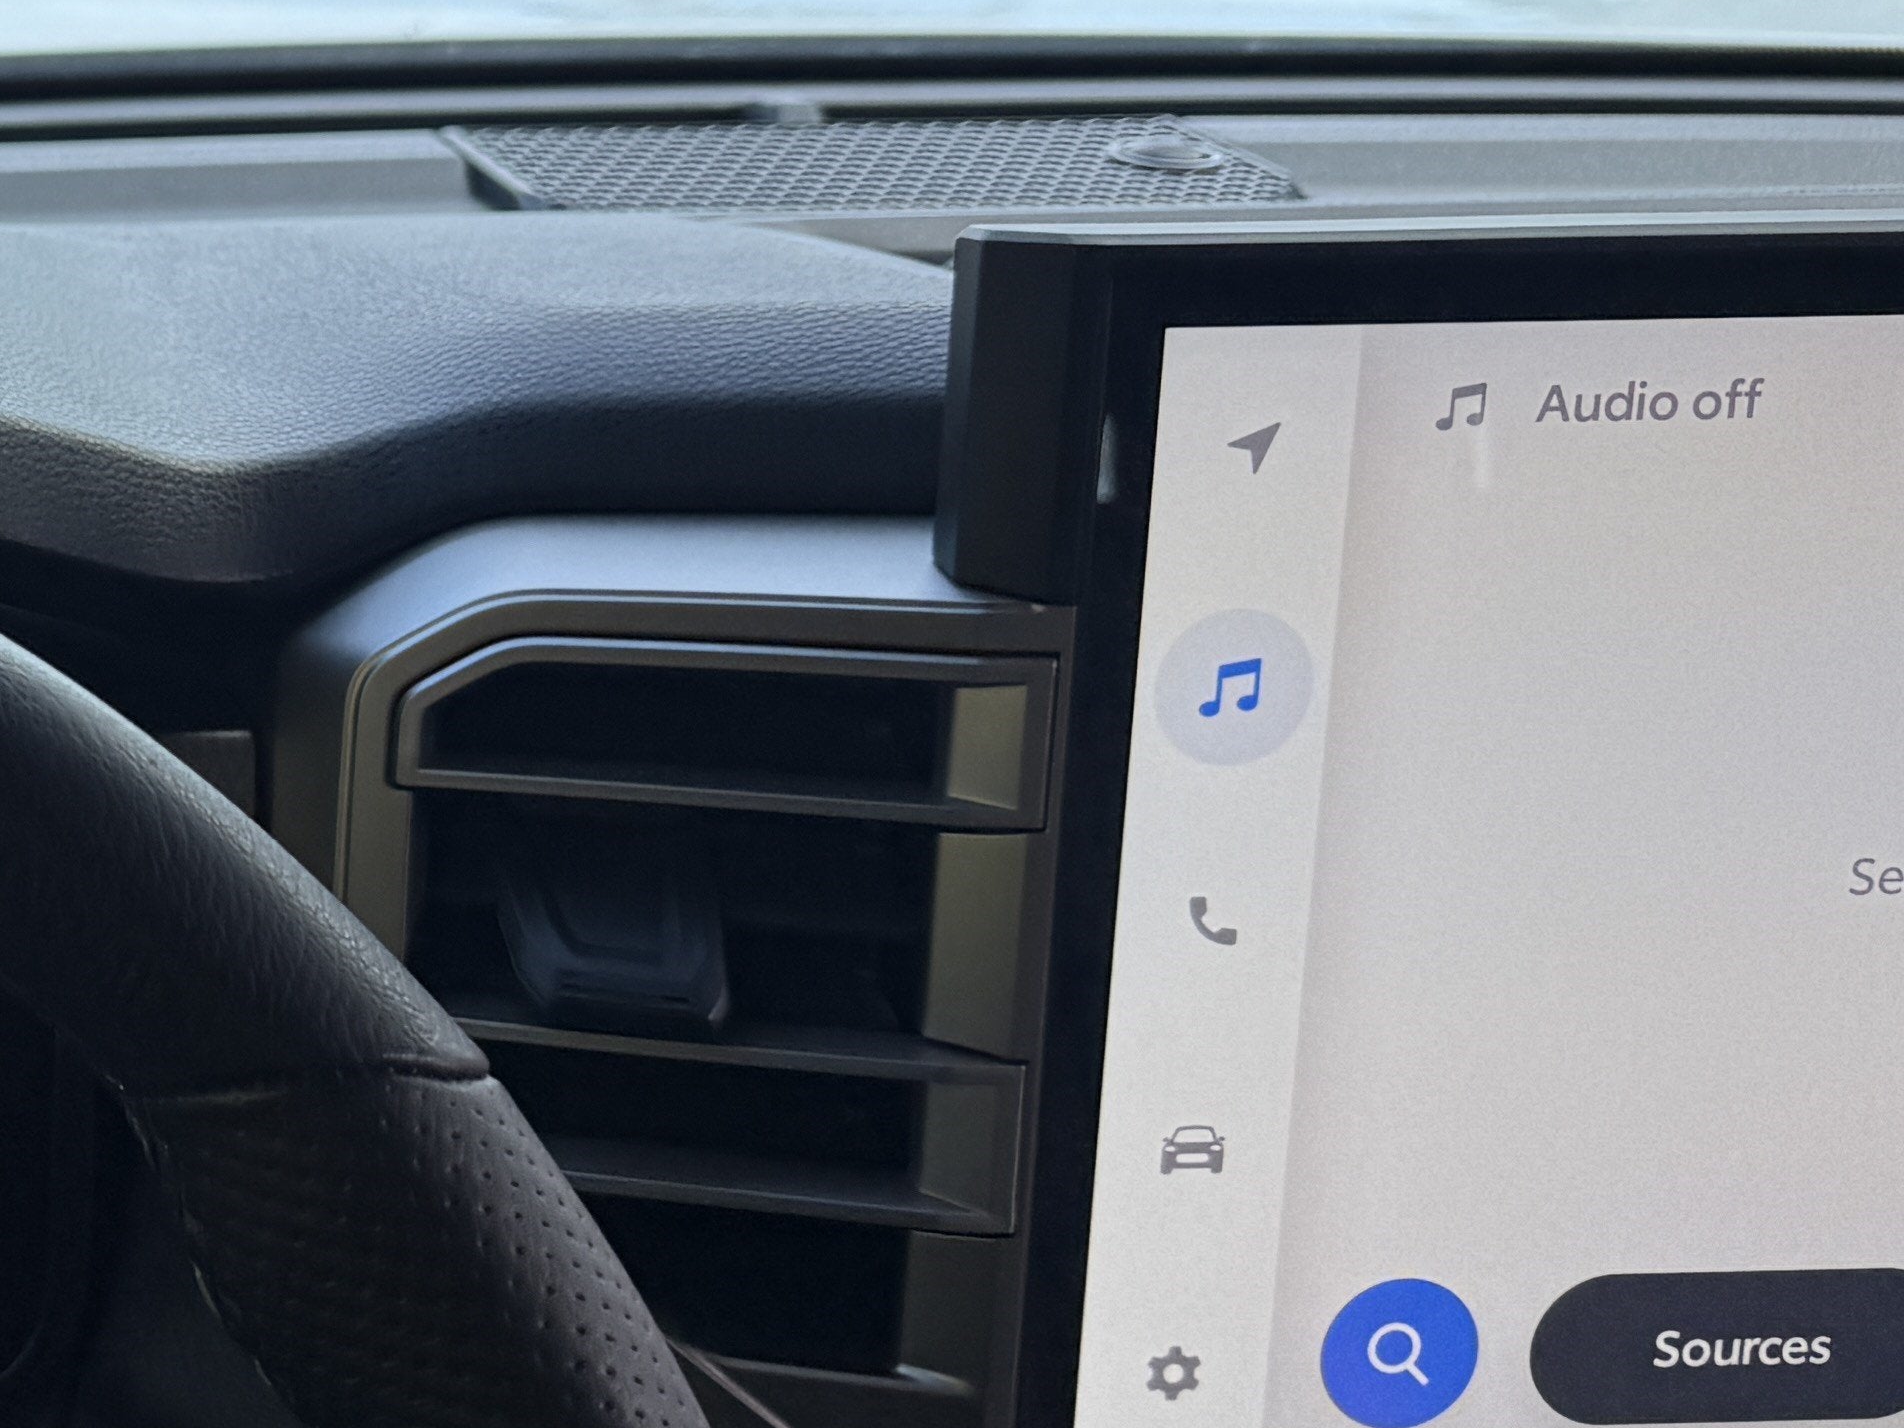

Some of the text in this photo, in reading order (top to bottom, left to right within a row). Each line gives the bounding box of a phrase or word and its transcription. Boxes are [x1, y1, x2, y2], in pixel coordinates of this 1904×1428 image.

[1535, 377, 1765, 424] Audio off
[1652, 1329, 1832, 1369] Sources
